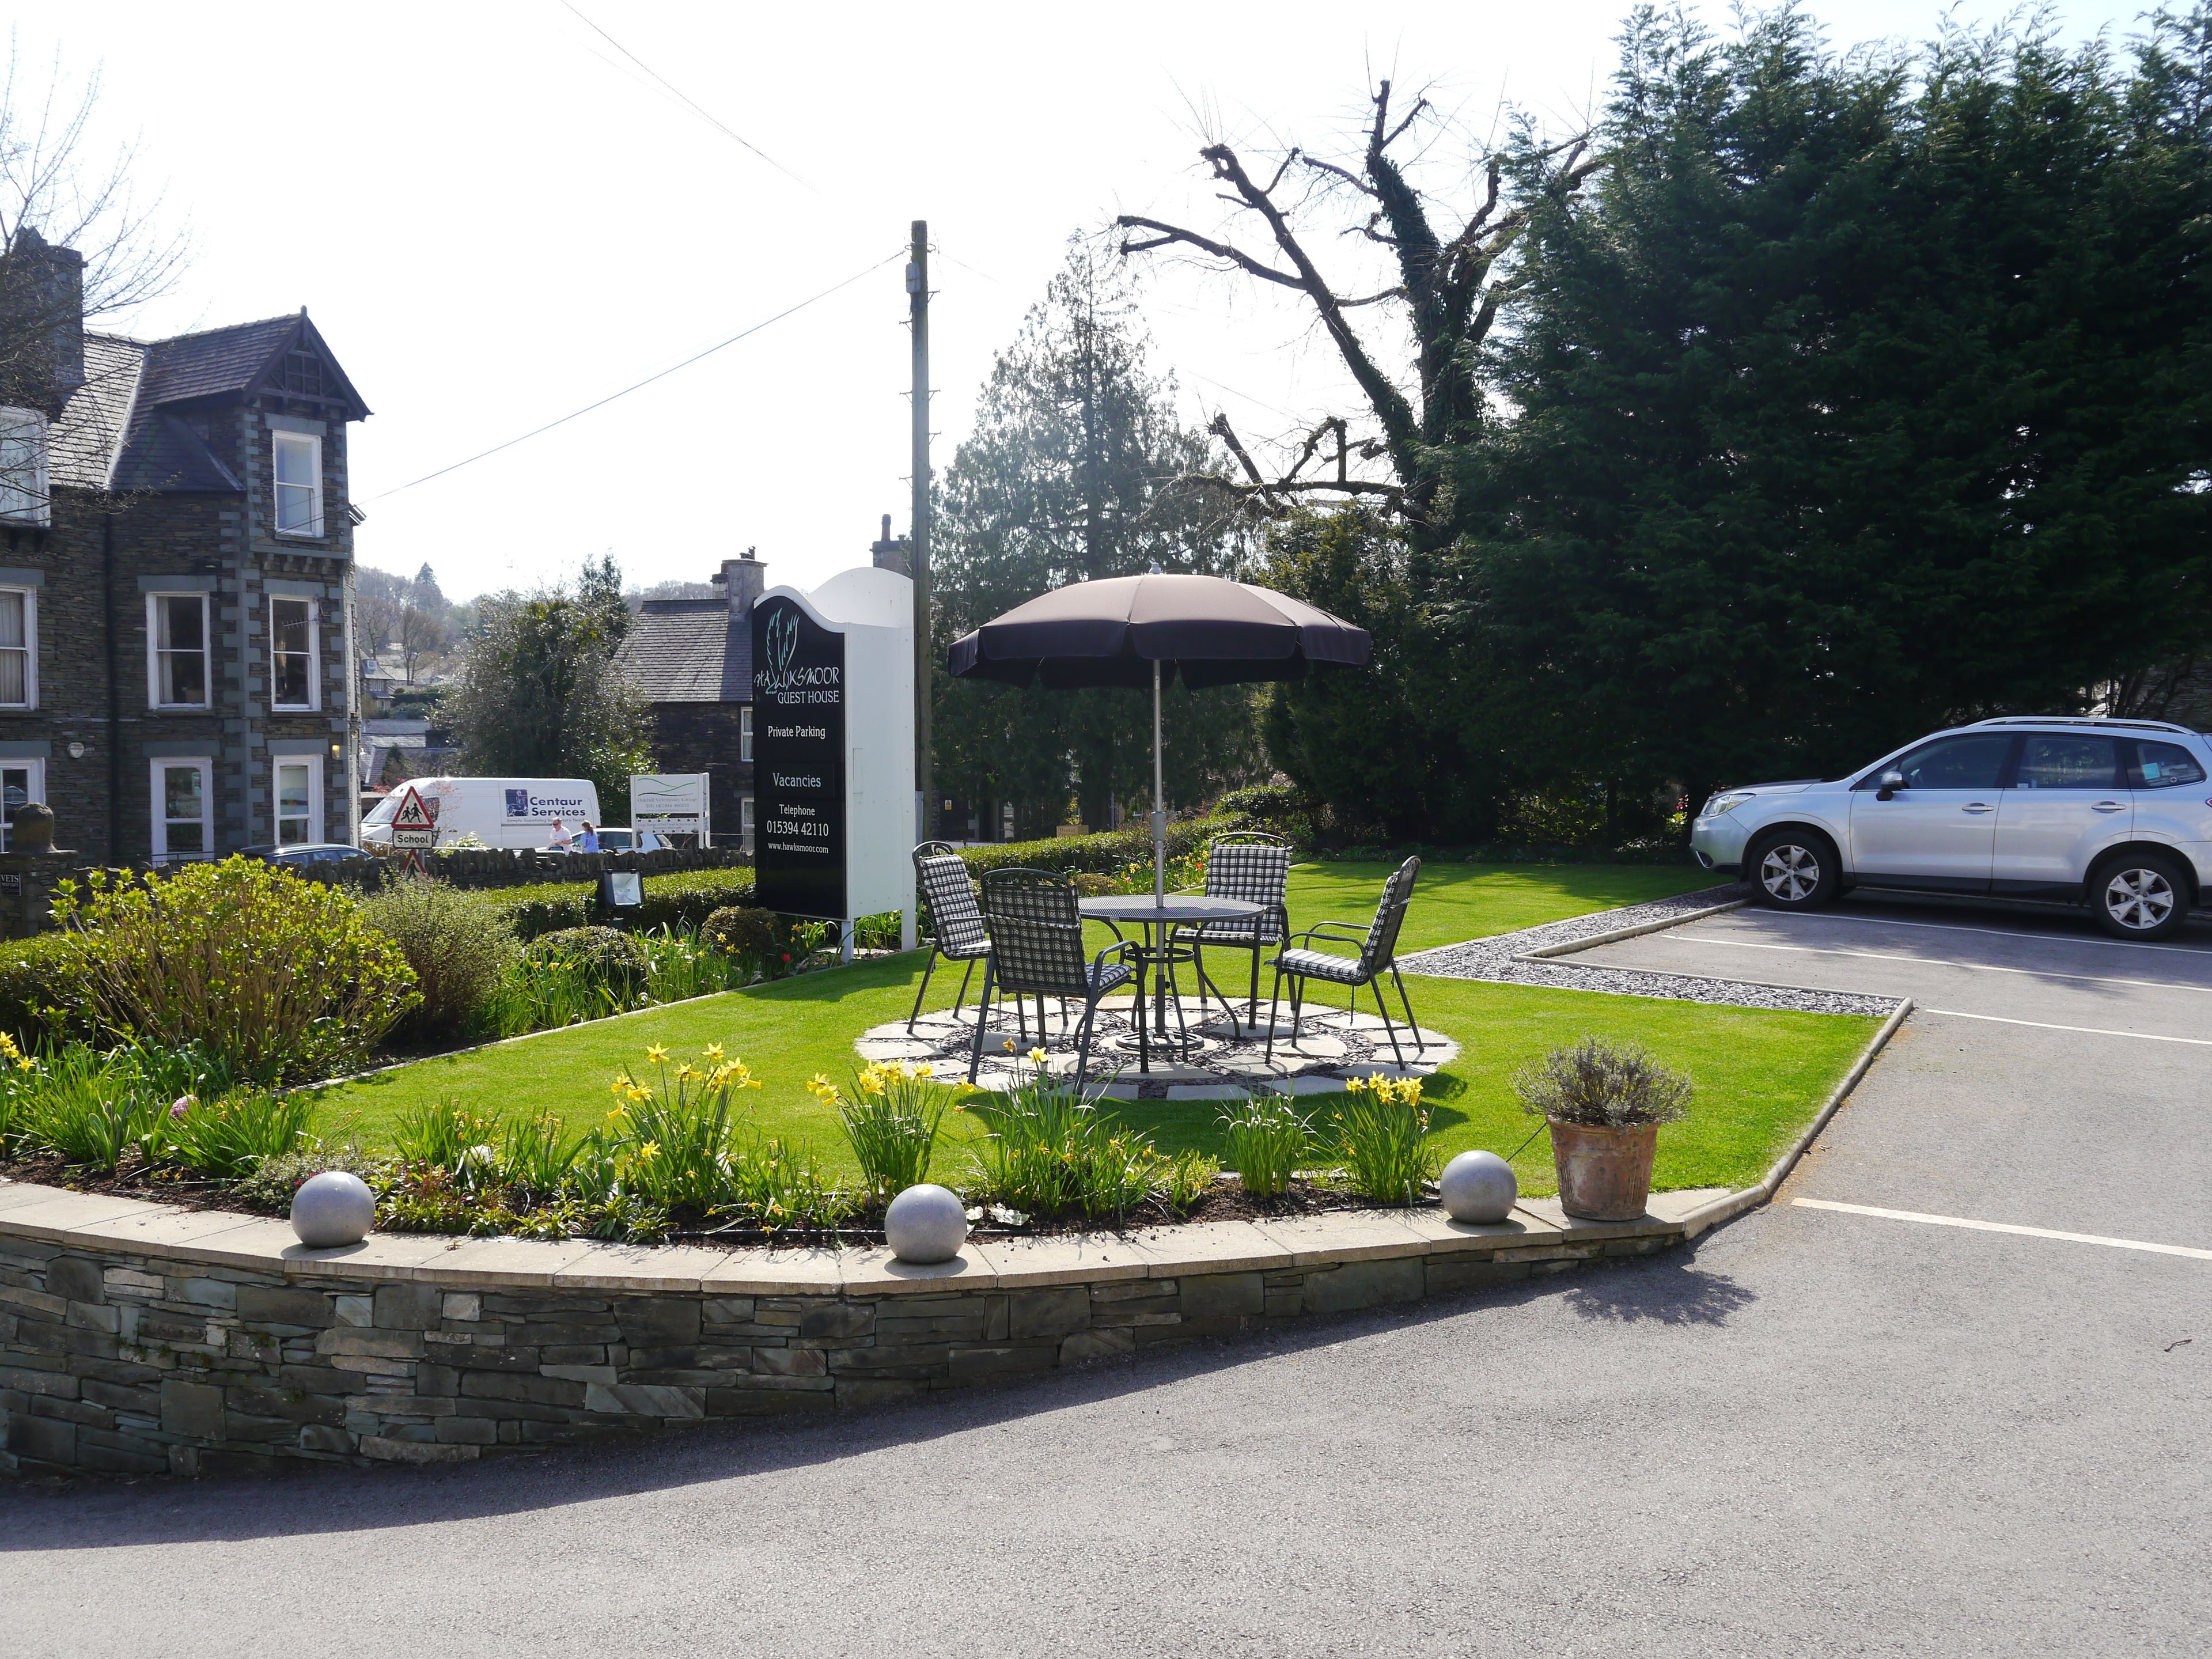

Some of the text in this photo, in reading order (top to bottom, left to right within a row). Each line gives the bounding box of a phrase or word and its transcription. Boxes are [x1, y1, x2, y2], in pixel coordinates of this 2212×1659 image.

[754, 667, 839, 690] HAWKSMOOR
[778, 690, 839, 704] GUEST HOUSE
[768, 725, 825, 739] Private Parking
[772, 772, 821, 787] Vacancies
[530, 797, 582, 805] Centaur
[532, 807, 586, 816] Services
[779, 804, 815, 817] Telephone
[767, 820, 829, 836] 015394 42110
[397, 835, 429, 843] School
[768, 842, 829, 854] www.hawksmoor.com
[1, 874, 18, 882] VETS
